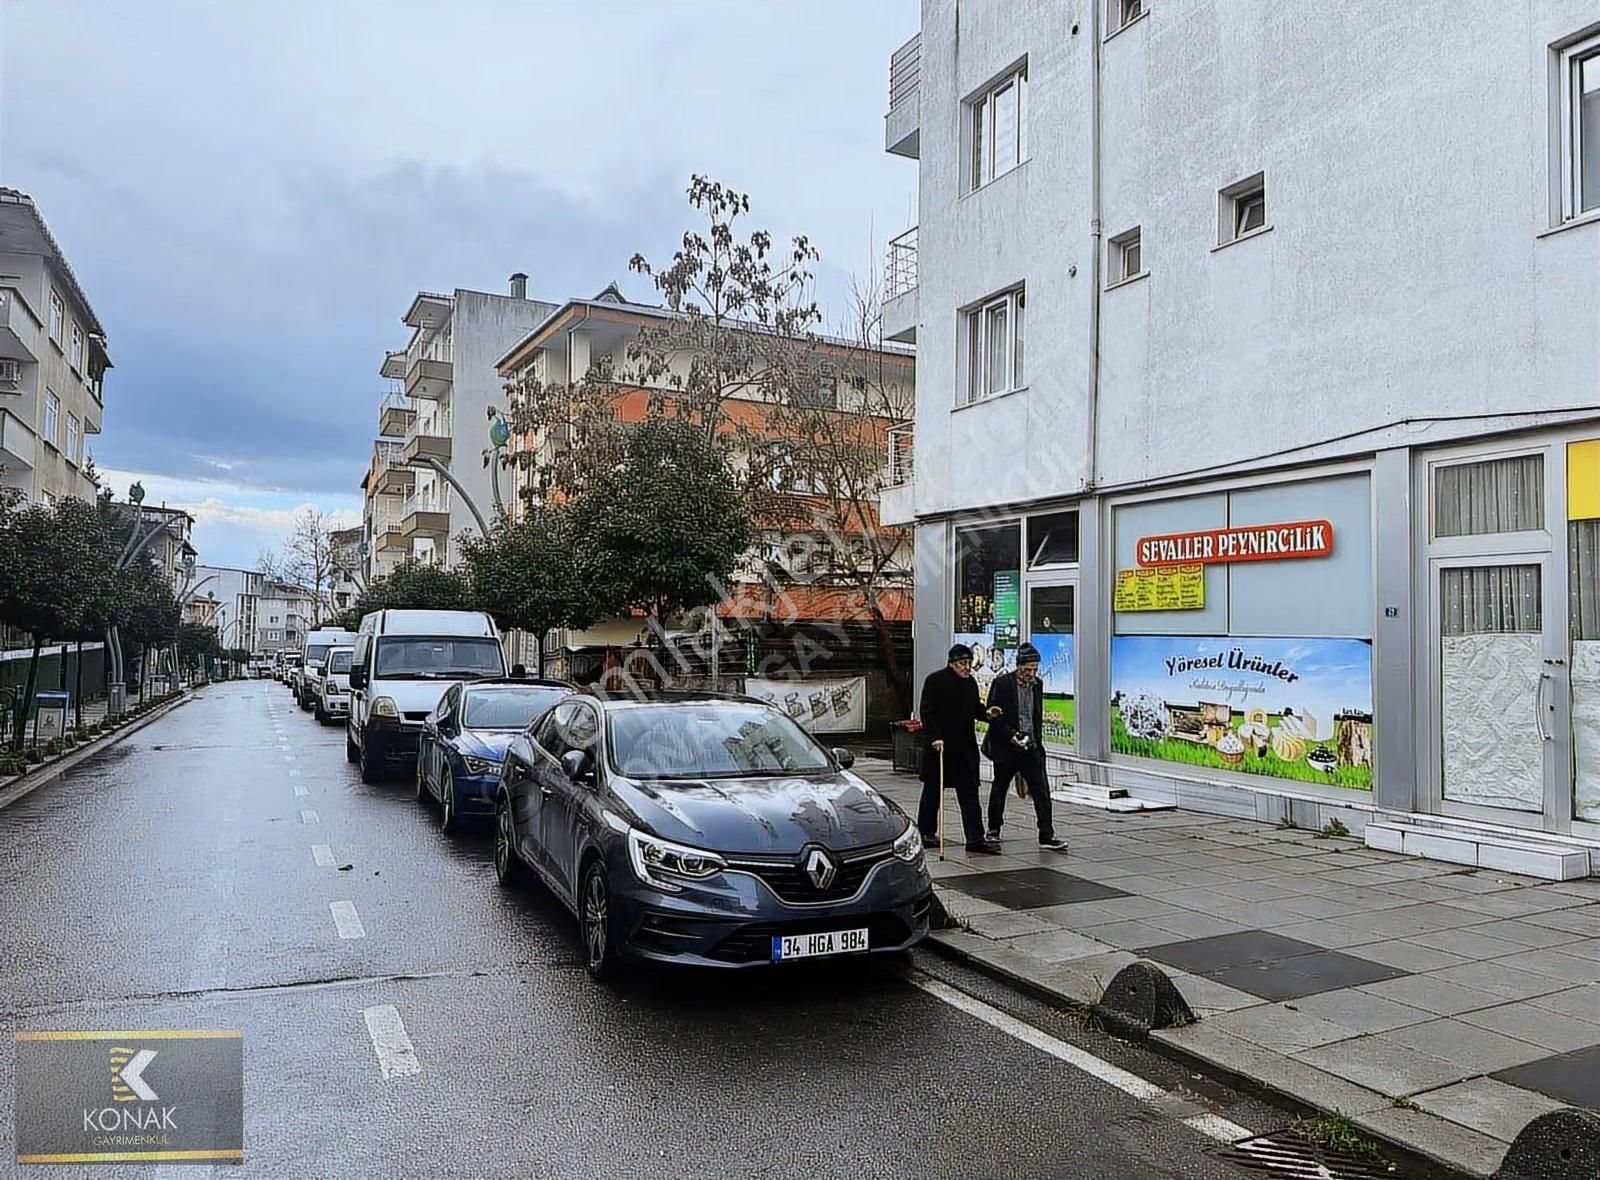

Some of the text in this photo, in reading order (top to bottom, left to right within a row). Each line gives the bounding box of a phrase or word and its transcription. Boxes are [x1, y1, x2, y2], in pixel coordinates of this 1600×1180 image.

[1142, 525, 1326, 562] SEVALLER PEYNİRCİLİK
[1165, 647, 1299, 683] Yöresel Ürünler
[783, 938, 801, 956] 34
[808, 935, 834, 954] HGA
[841, 931, 865, 950] 984
